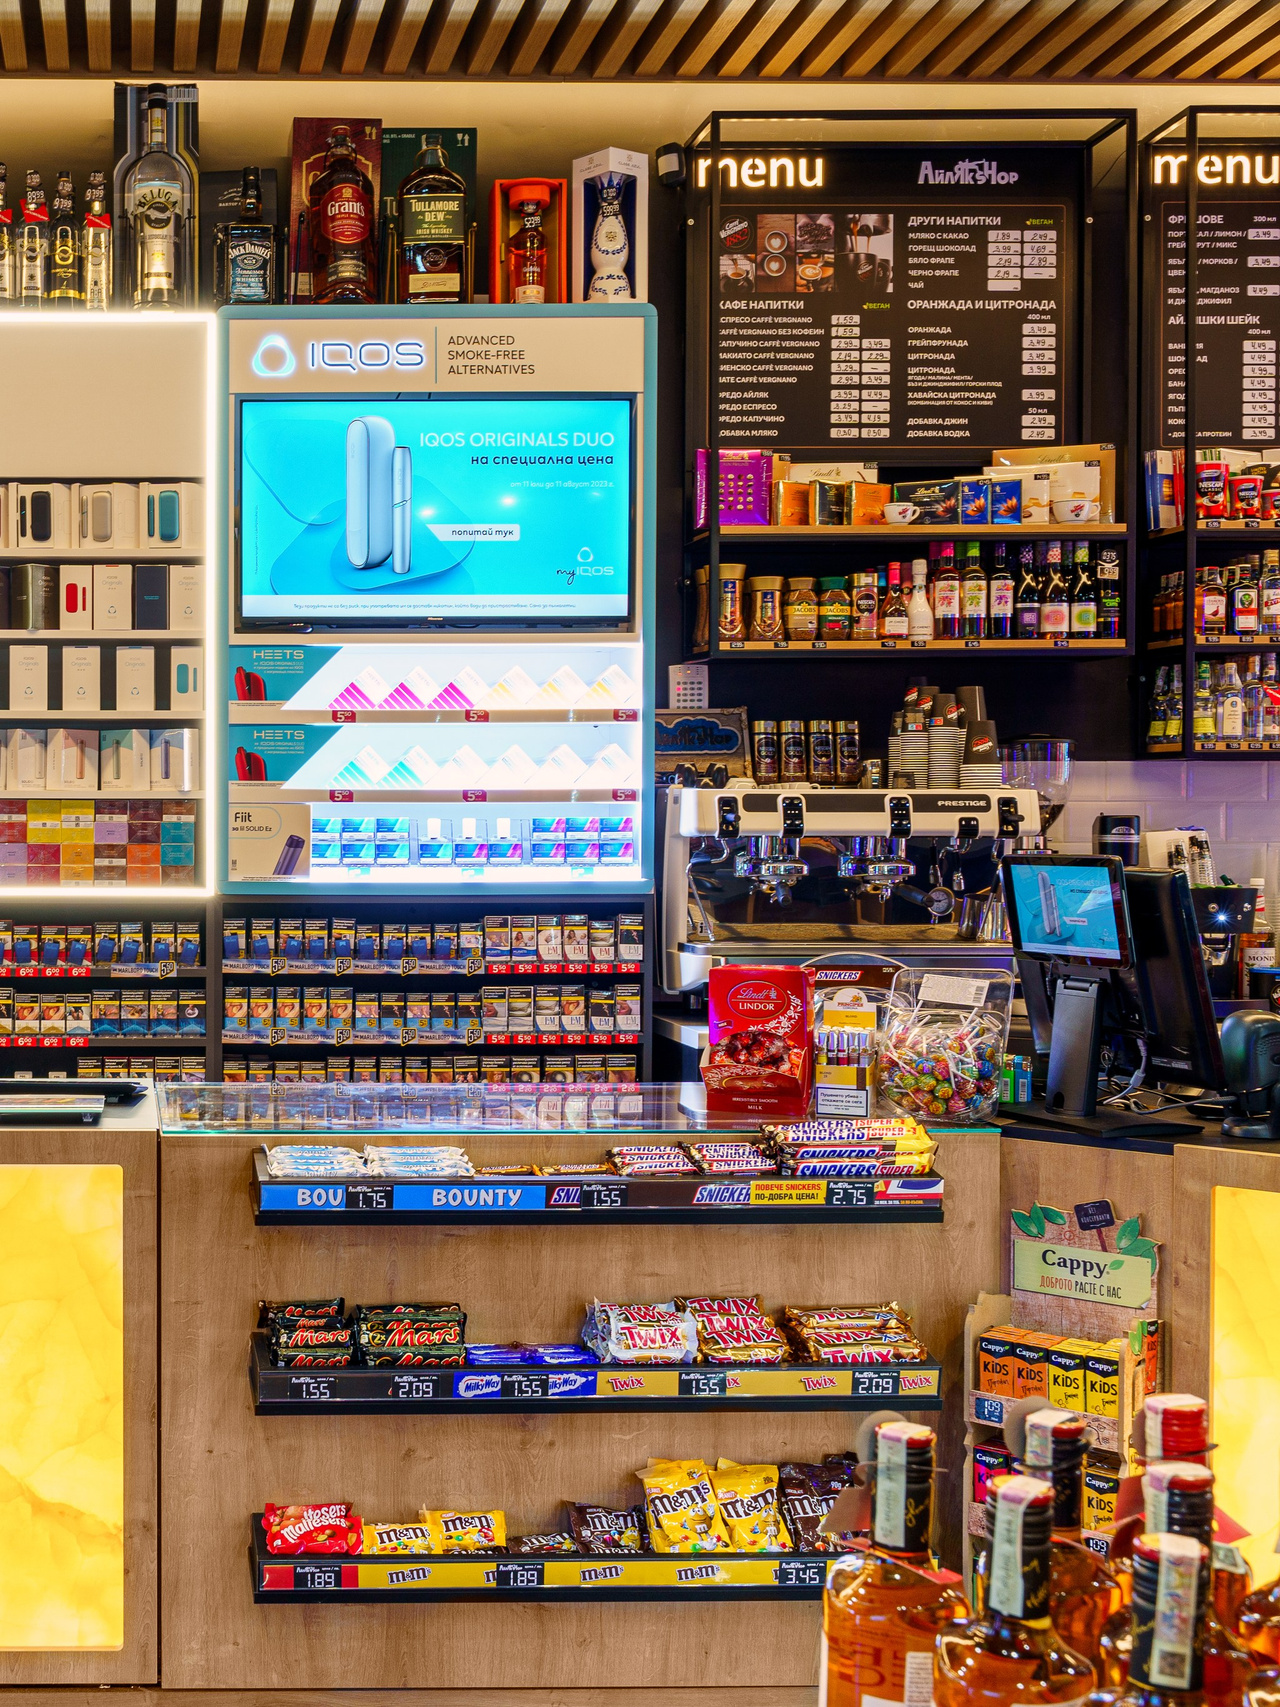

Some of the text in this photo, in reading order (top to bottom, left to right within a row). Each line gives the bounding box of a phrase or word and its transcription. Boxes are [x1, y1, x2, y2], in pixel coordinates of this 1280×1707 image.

[698, 158, 823, 188] menu
[137, 188, 178, 212] BELUGA
[410, 200, 459, 211] TULLAMORE
[328, 201, 364, 217] Grant's
[908, 217, 1001, 227] ДРУГИ НАПИТКИ
[229, 242, 272, 259] JACK DANIEL'S
[750, 301, 804, 309] НАПИТКИ
[907, 300, 1056, 310] ОРАНЖАДА И ЦИТРОНАДА
[1226, 314, 1260, 325] ШЕЙК
[448, 335, 515, 346] ADVANCED
[908, 339, 968, 347] ГРЕЙПФРУНАДА
[311, 342, 423, 371] IQOS
[448, 350, 525, 360] SMOKE-FREE
[448, 364, 535, 375] ALTERNATIVES
[908, 391, 948, 399] ХАВАЙСКА
[420, 432, 614, 447] IQOS ORIGINALS DUO
[471, 455, 613, 469] на специална цена
[452, 528, 514, 538] попитай тук
[253, 650, 304, 659] HEETS
[816, 971, 861, 981] SNICKERS
[739, 1002, 775, 1011] LINDOR
[755, 1183, 784, 1191] ПОВЕЧЕ
[359, 1193, 386, 1208] 1.75
[433, 1189, 522, 1206] BOUNTY
[755, 1192, 818, 1201] ПО-ДОБРА ЦЕНА!
[834, 1190, 866, 1204] 2.75
[1041, 1249, 1107, 1279] Cappy
[1040, 1276, 1122, 1298] ДОБРОТО РАСТЕ С НАС
[291, 1329, 350, 1347] Mars
[982, 1342, 1005, 1353] Cappy
[399, 1383, 432, 1397] 2.09
[281, 1518, 346, 1543] Maltesers
[307, 1573, 334, 1587] 1.89
[786, 1569, 819, 1584] 3.45
